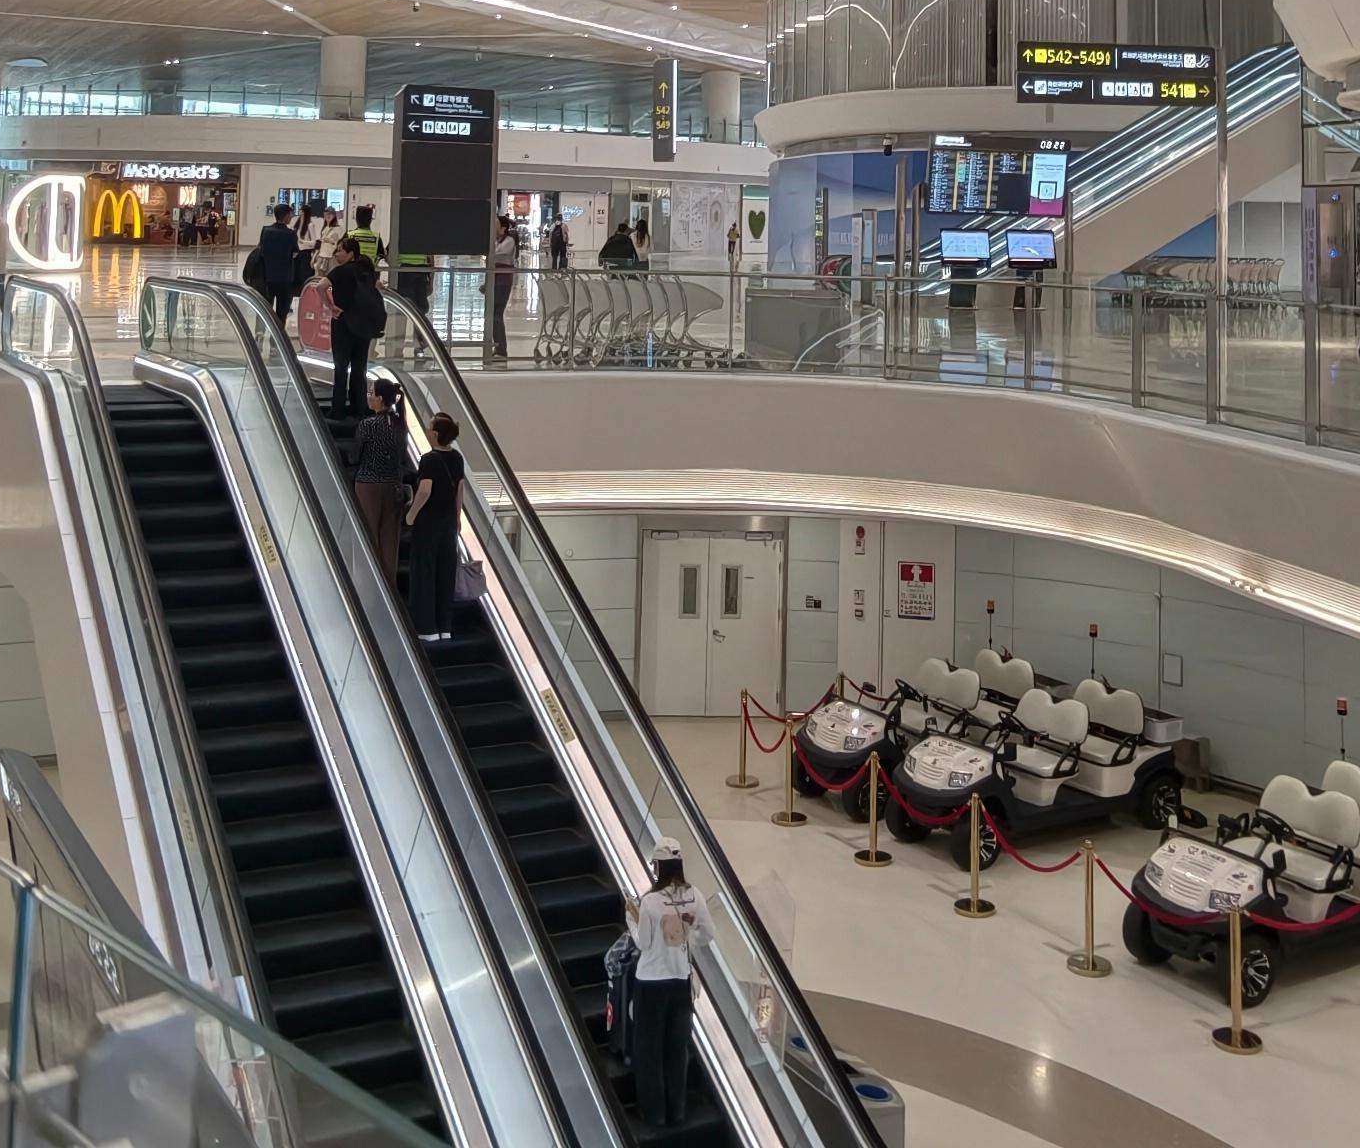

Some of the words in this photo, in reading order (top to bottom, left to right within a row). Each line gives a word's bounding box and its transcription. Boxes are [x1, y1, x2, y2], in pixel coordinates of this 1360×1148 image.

[1048, 49, 1105, 65] 542-549
[1161, 82, 1184, 98] 541
[122, 163, 220, 180] McDonald's
